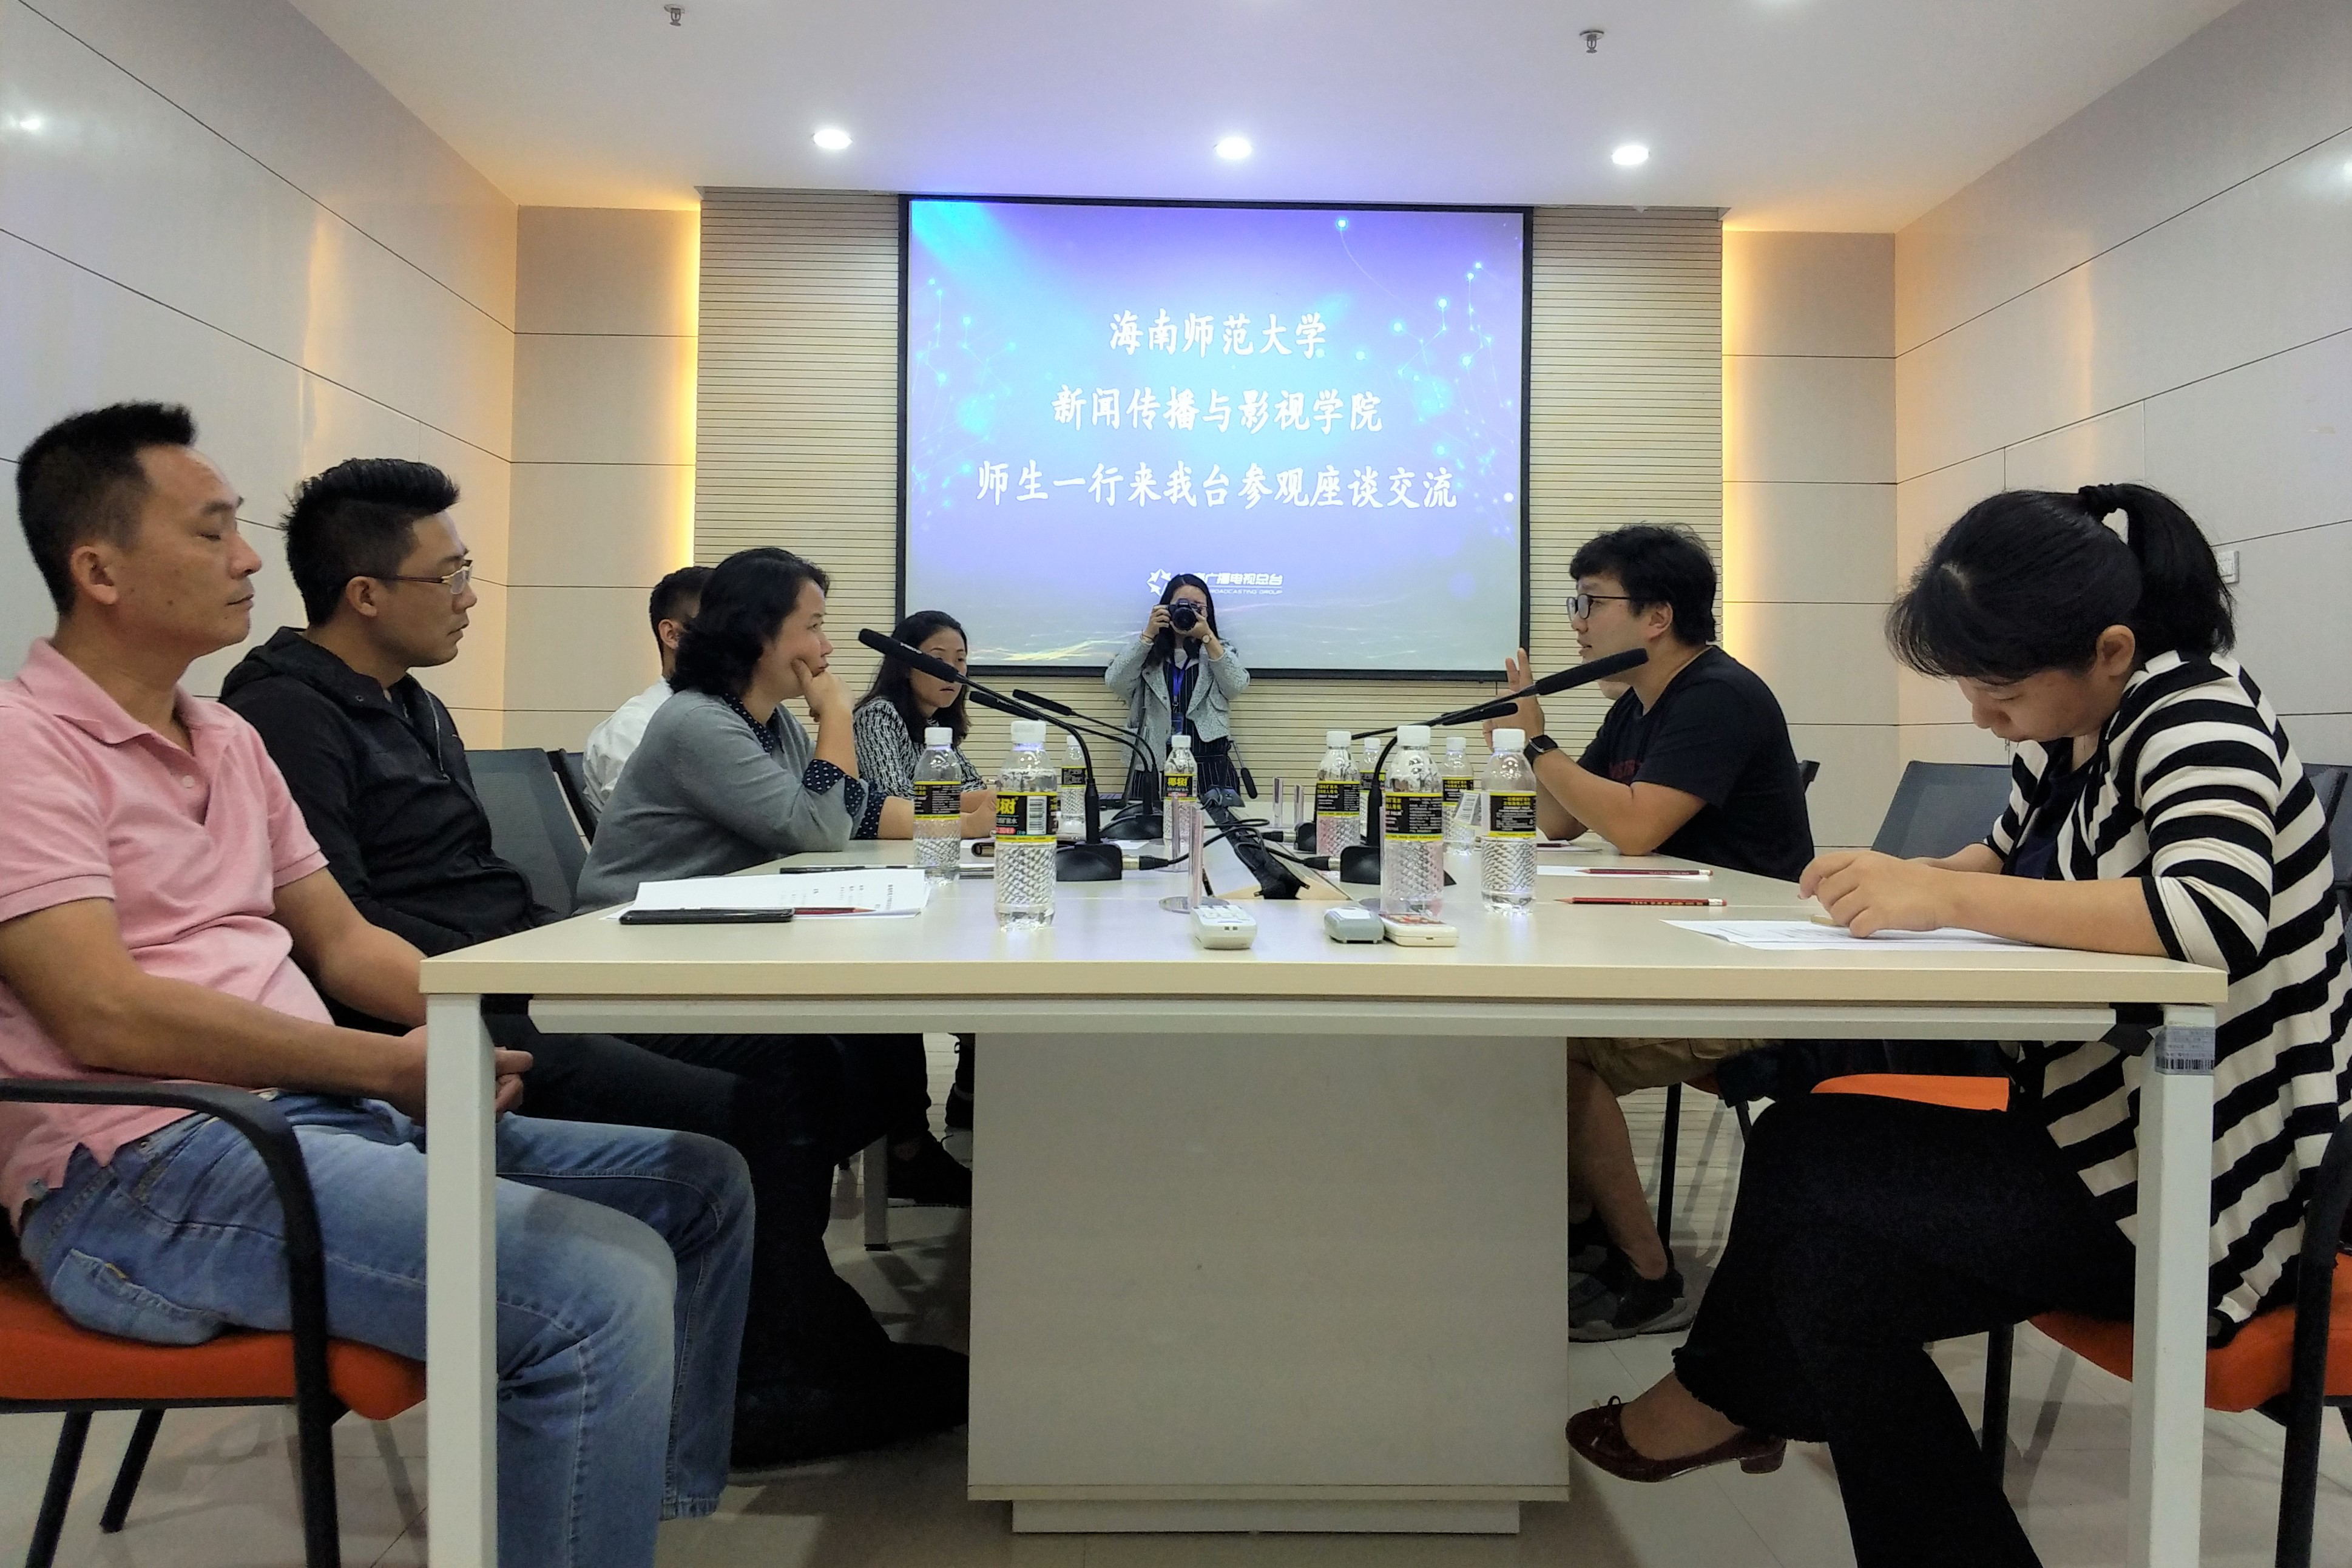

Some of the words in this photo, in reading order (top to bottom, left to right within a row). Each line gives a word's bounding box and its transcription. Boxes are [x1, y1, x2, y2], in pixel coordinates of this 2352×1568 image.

[1109, 308, 1327, 360] 海南师范大学
[1050, 384, 1383, 435] 新闻传播与影视学院
[976, 459, 1458, 510] 师生一行来我台参观座谈交流
